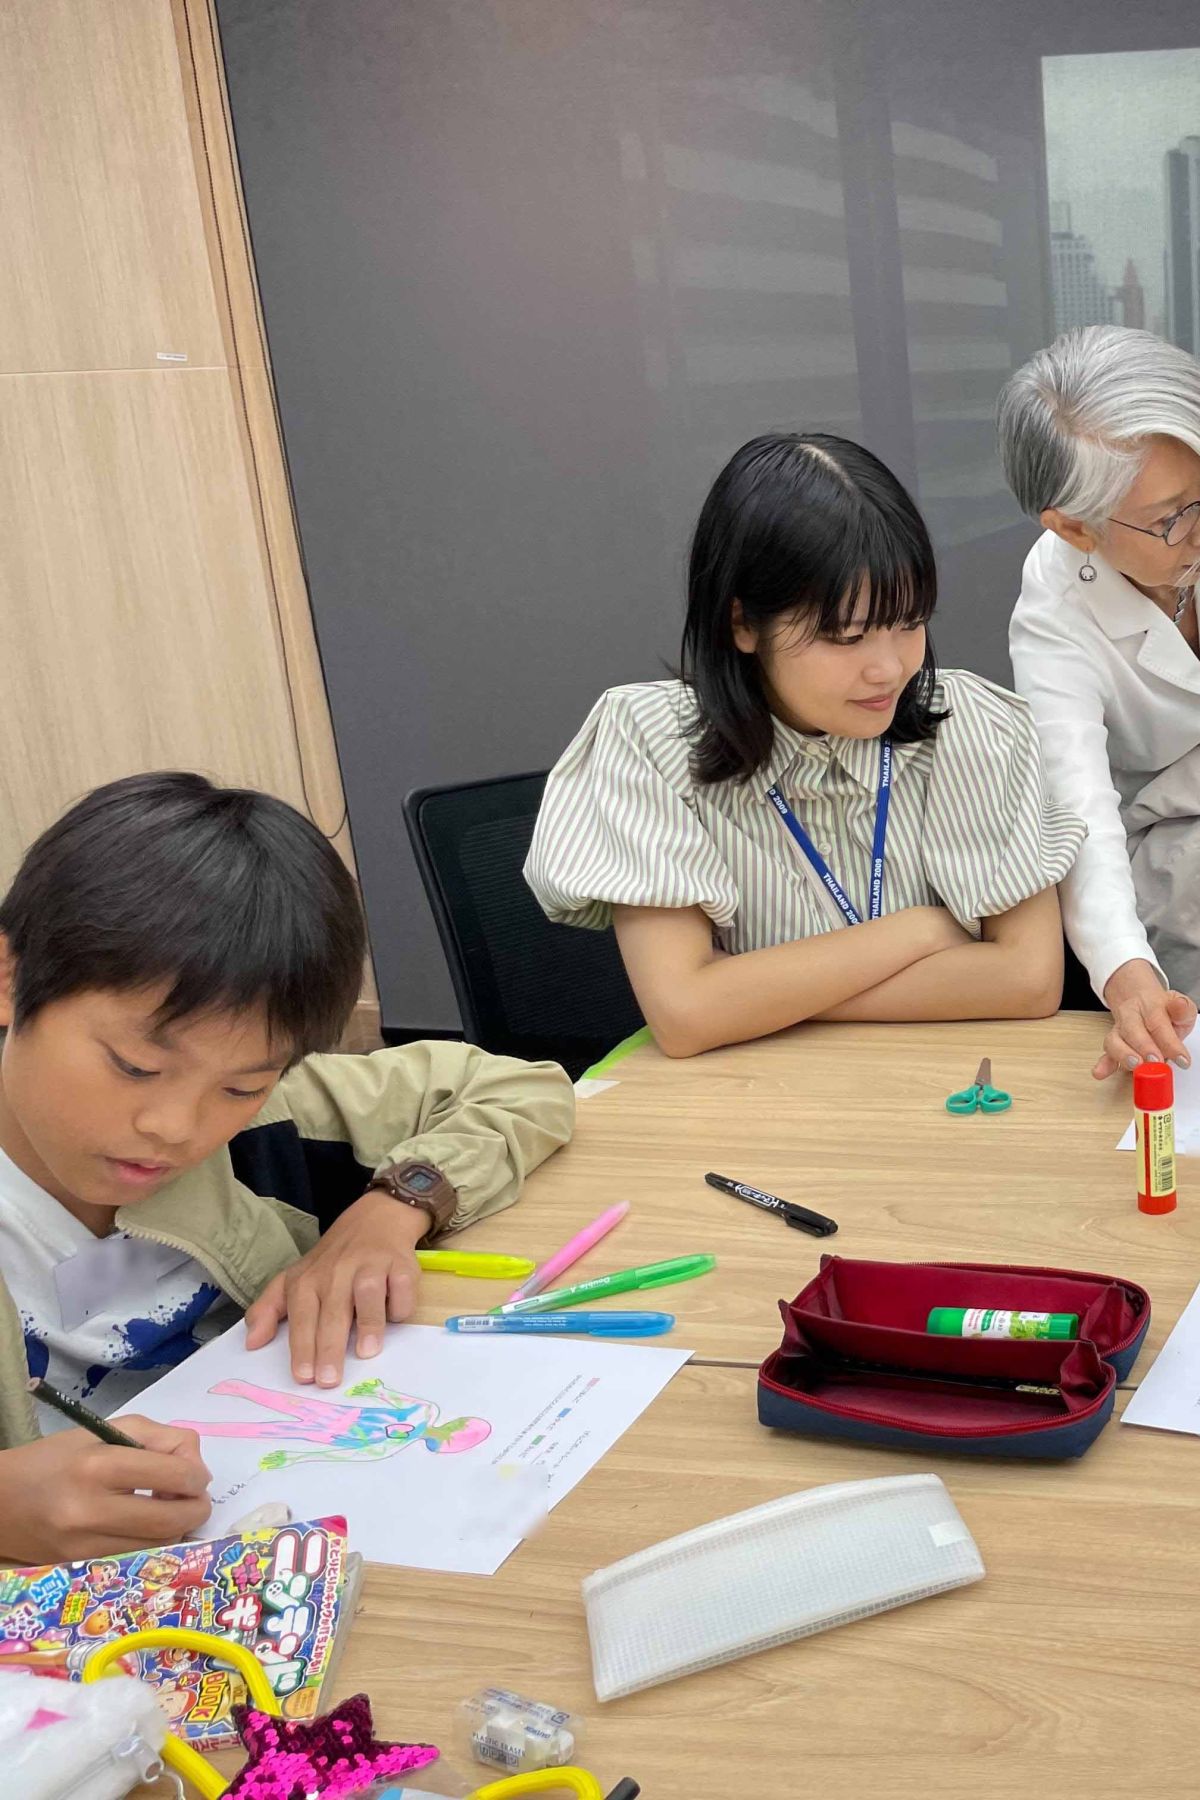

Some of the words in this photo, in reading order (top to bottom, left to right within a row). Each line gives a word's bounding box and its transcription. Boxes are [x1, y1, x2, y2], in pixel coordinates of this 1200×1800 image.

[882, 746, 891, 788] THAILAND
[772, 795, 788, 815] 2009
[874, 858, 883, 877] 2009
[823, 872, 850, 910] THAILAND
[845, 907, 861, 925] 200
[871, 878, 881, 919] THAILAND
[570, 1286, 577, 1294] A
[579, 1277, 611, 1290] Double
[191, 1672, 227, 1719] BOOK
[472, 1732, 498, 1746] PLASTIC
[500, 1742, 526, 1757] ERASER
